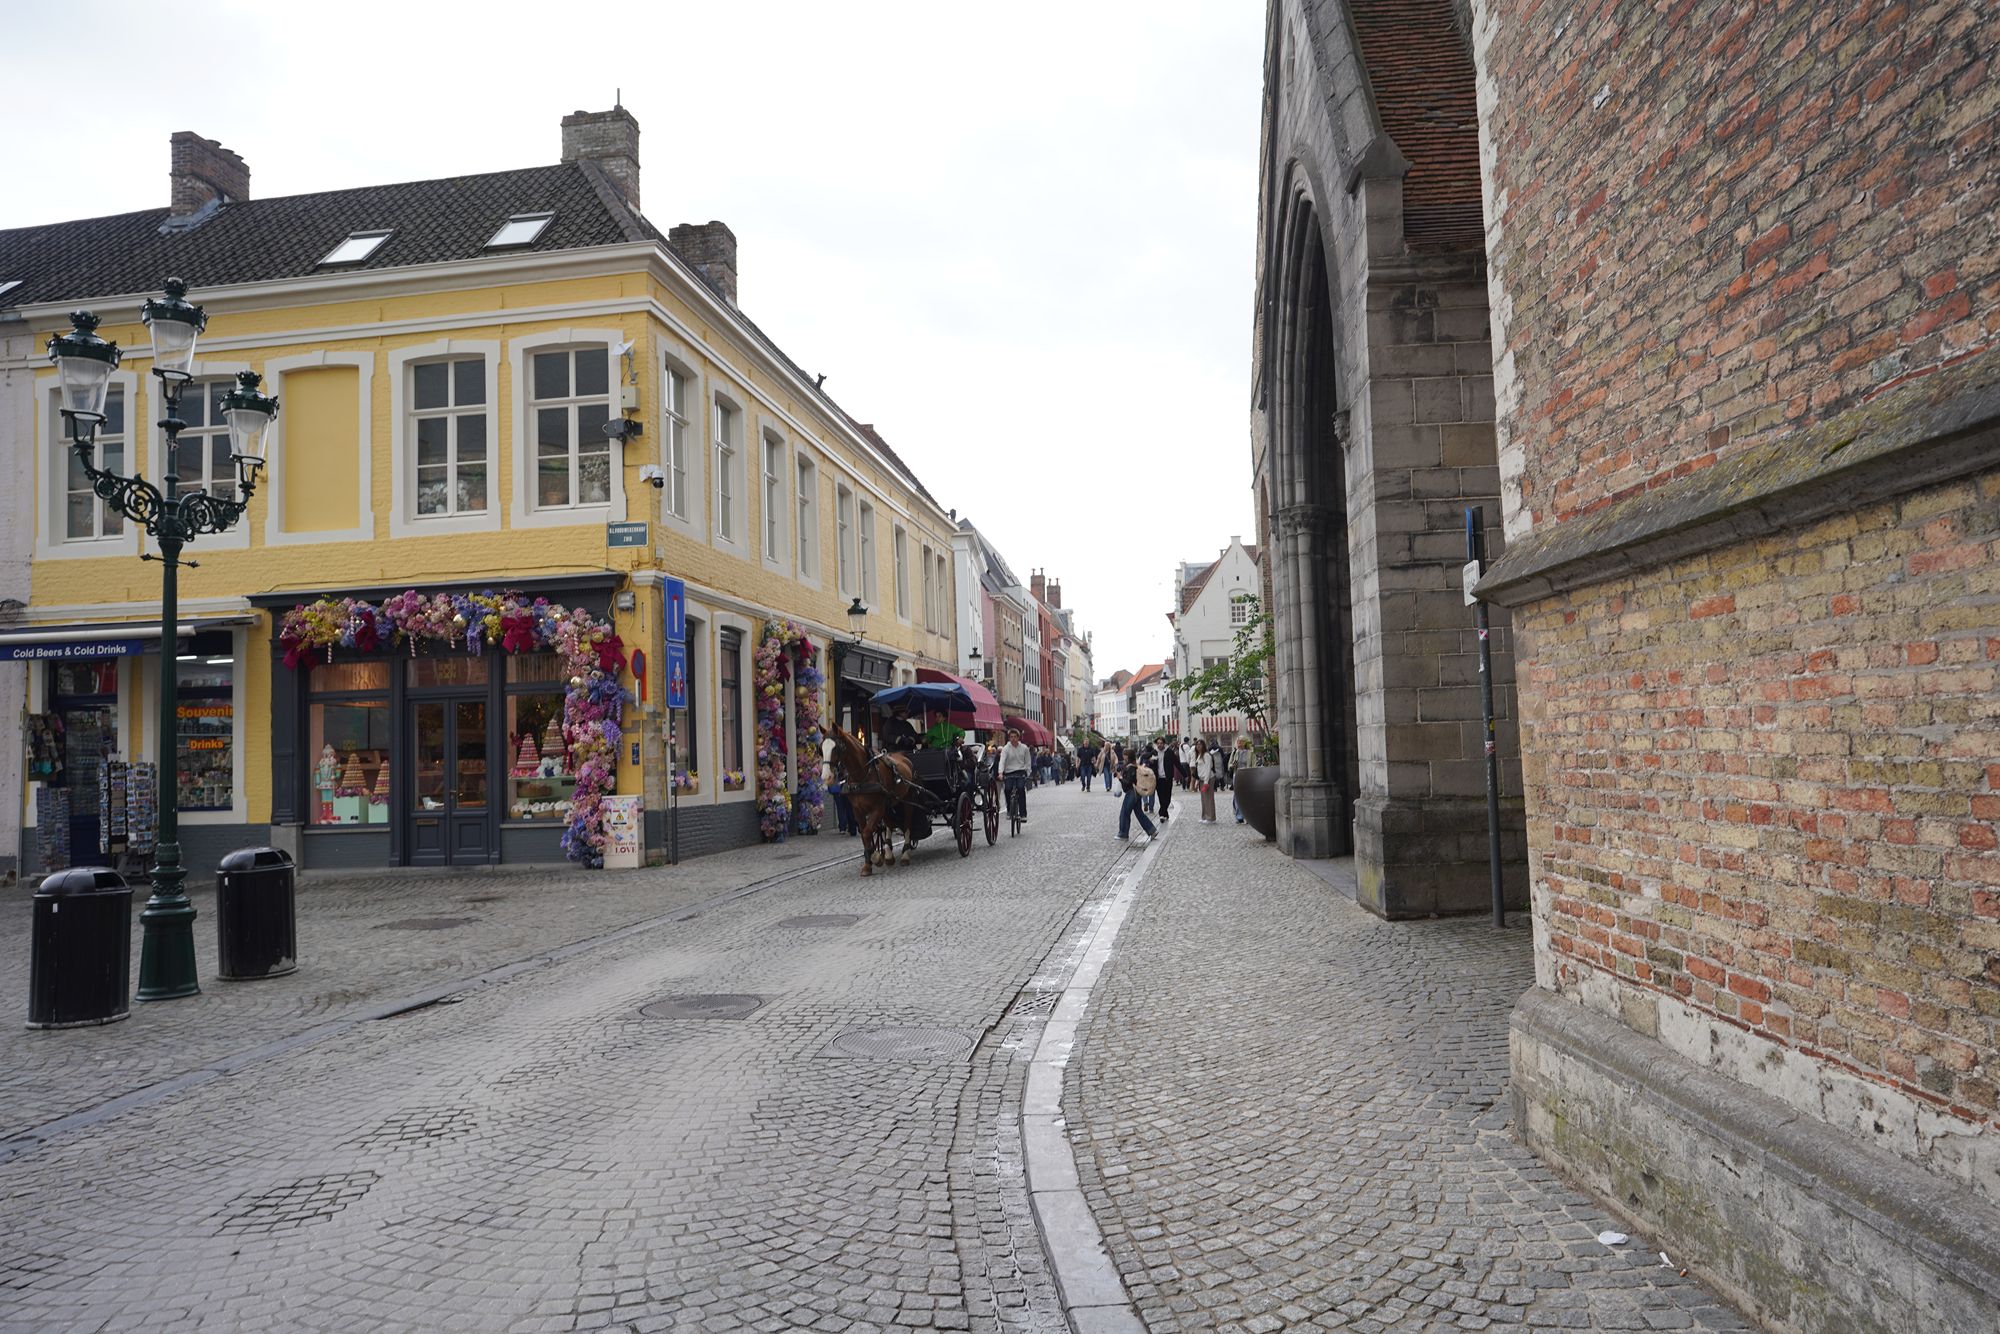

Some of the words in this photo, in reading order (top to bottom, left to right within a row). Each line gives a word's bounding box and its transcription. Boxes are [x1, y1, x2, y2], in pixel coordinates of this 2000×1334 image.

[13, 649, 34, 658] Cold
[36, 648, 62, 657] Beers
[64, 646, 71, 656] &
[73, 645, 95, 655] Cold
[97, 645, 127, 655] Drinks
[189, 739, 225, 750] Drinks
